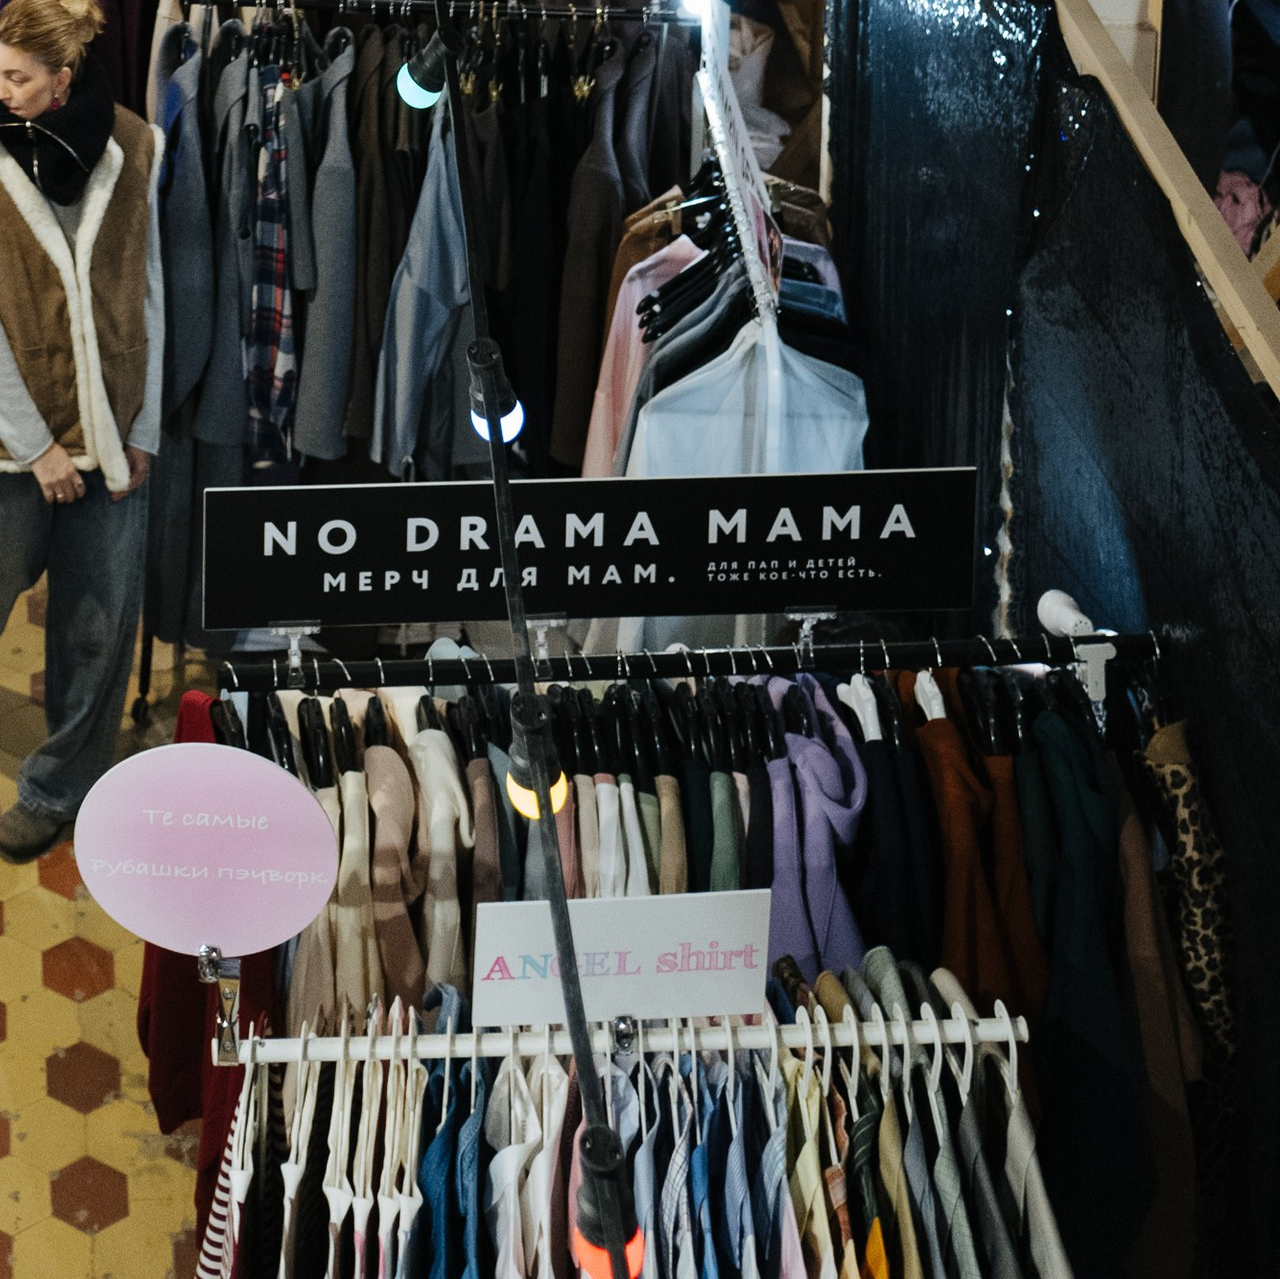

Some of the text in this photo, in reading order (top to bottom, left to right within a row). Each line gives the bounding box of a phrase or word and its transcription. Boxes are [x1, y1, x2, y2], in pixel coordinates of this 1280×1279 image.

[263, 504, 916, 556] NO DRAMA MAMA
[707, 556, 856, 571] ДЛЯ ПАП И ДЕТЕЙ
[323, 569, 429, 592] МЕРЧ
[567, 563, 676, 586] МАМ.
[707, 569, 882, 582] ТОЖЕ КОЕ-ЧТО ЕСТЬ.
[142, 809, 269, 830] Те самые
[218, 868, 328, 889] пэчворк
[656, 941, 759, 973] shirt
